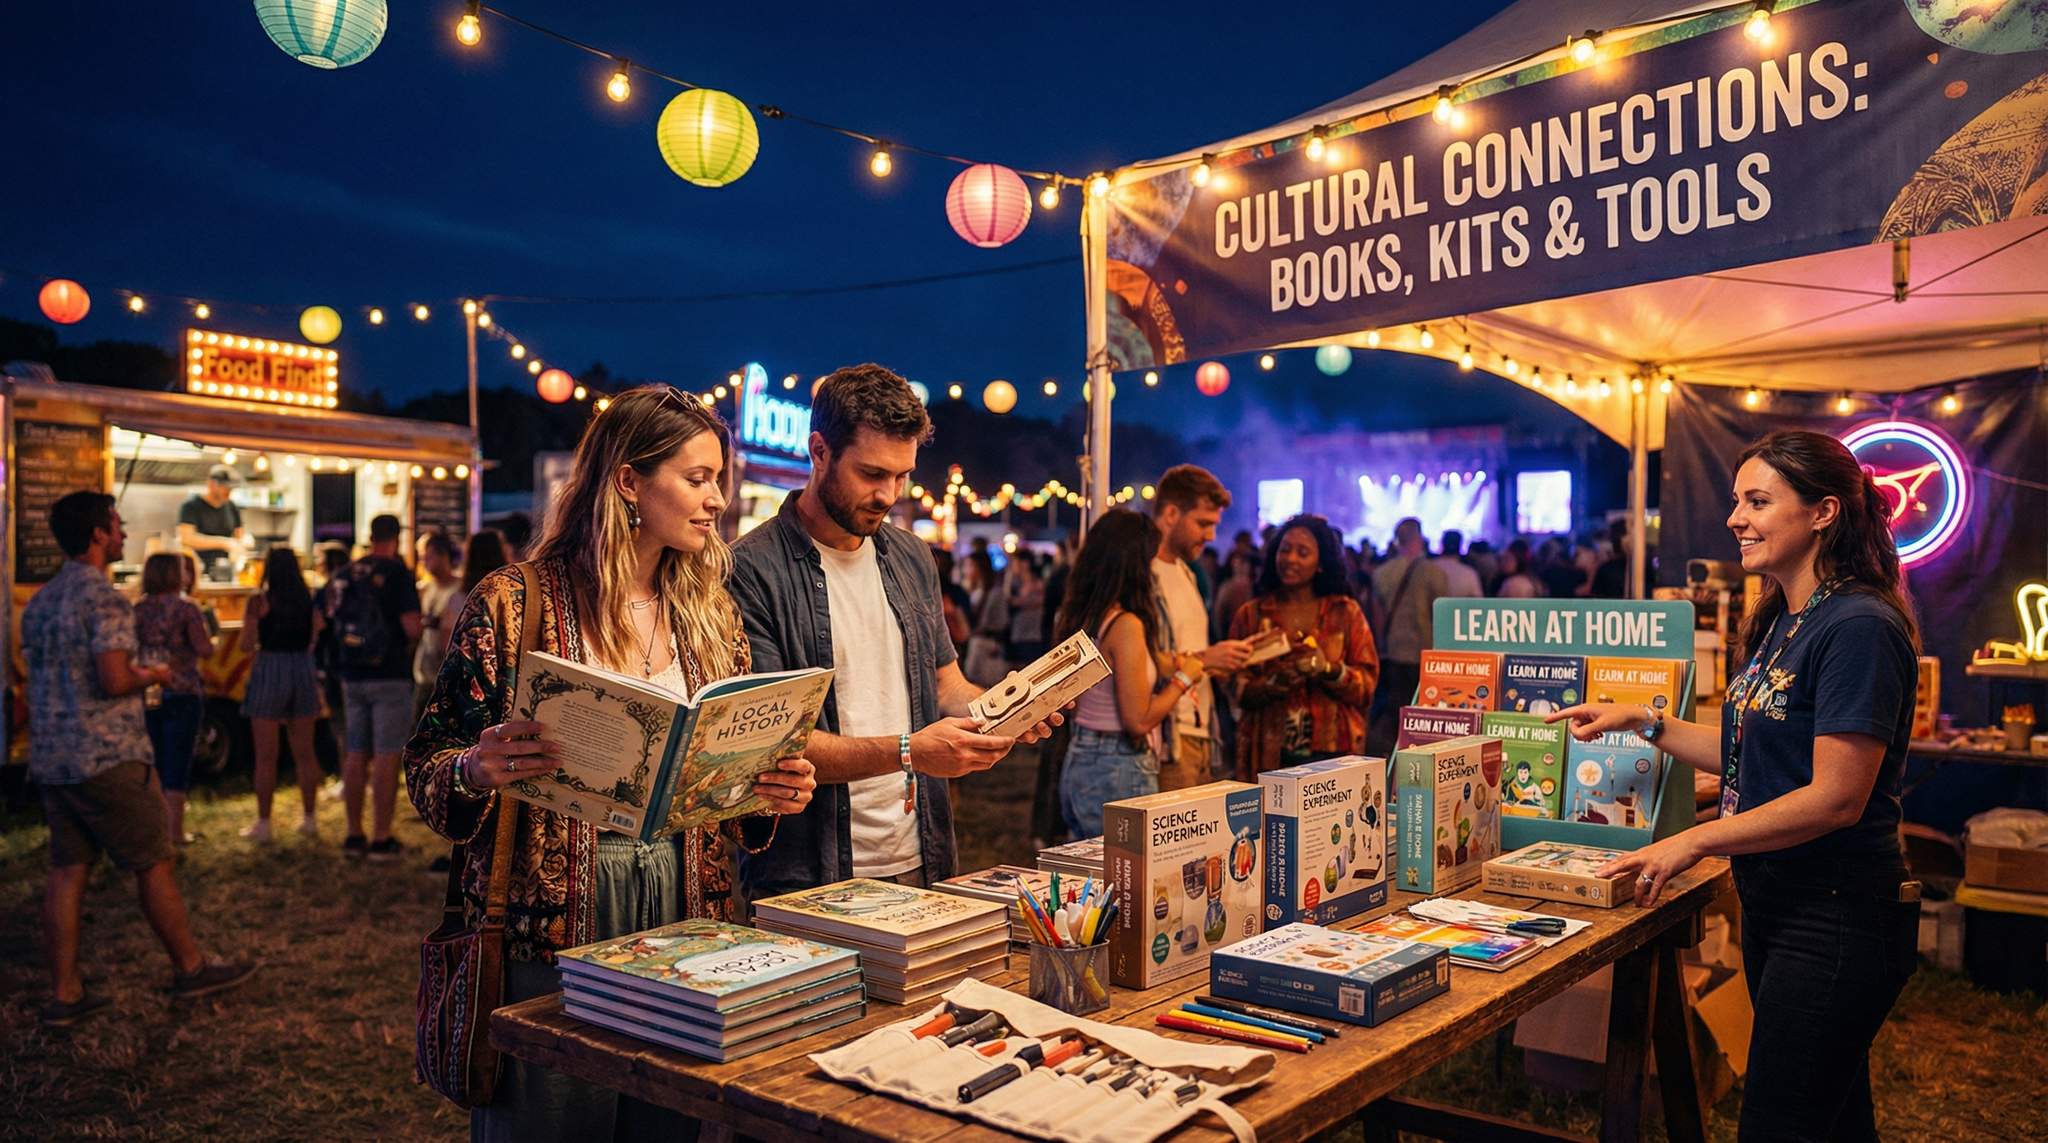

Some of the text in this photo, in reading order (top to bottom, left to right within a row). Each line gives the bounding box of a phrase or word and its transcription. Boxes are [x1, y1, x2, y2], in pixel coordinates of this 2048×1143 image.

[1215, 41, 1870, 260] CULTURAL CONNECTIONS:
[1271, 152, 1773, 313] BOOKS, KITS & TOOLS
[201, 347, 325, 391] Food Find
[1453, 609, 1667, 647] LEARN AT HOME
[1425, 662, 1491, 677] LEARN AT HOME
[1508, 665, 1578, 680] LEARN AT HOME
[1593, 669, 1668, 684] LEARN AT HOME
[732, 699, 789, 723] LOCAL
[716, 711, 795, 740] HISTORY
[1404, 718, 1470, 735] LEARN AT HOME
[1487, 724, 1516, 739] LEARN
[1518, 726, 1530, 739] AT
[1532, 727, 1558, 742] HOME
[1608, 733, 1621, 746] AT
[1303, 779, 1337, 797] SCIENCE
[1303, 789, 1353, 811] EXPERIMENT
[1152, 809, 1198, 831] SCIENCE
[1153, 820, 1219, 847] EXPERIMENT
